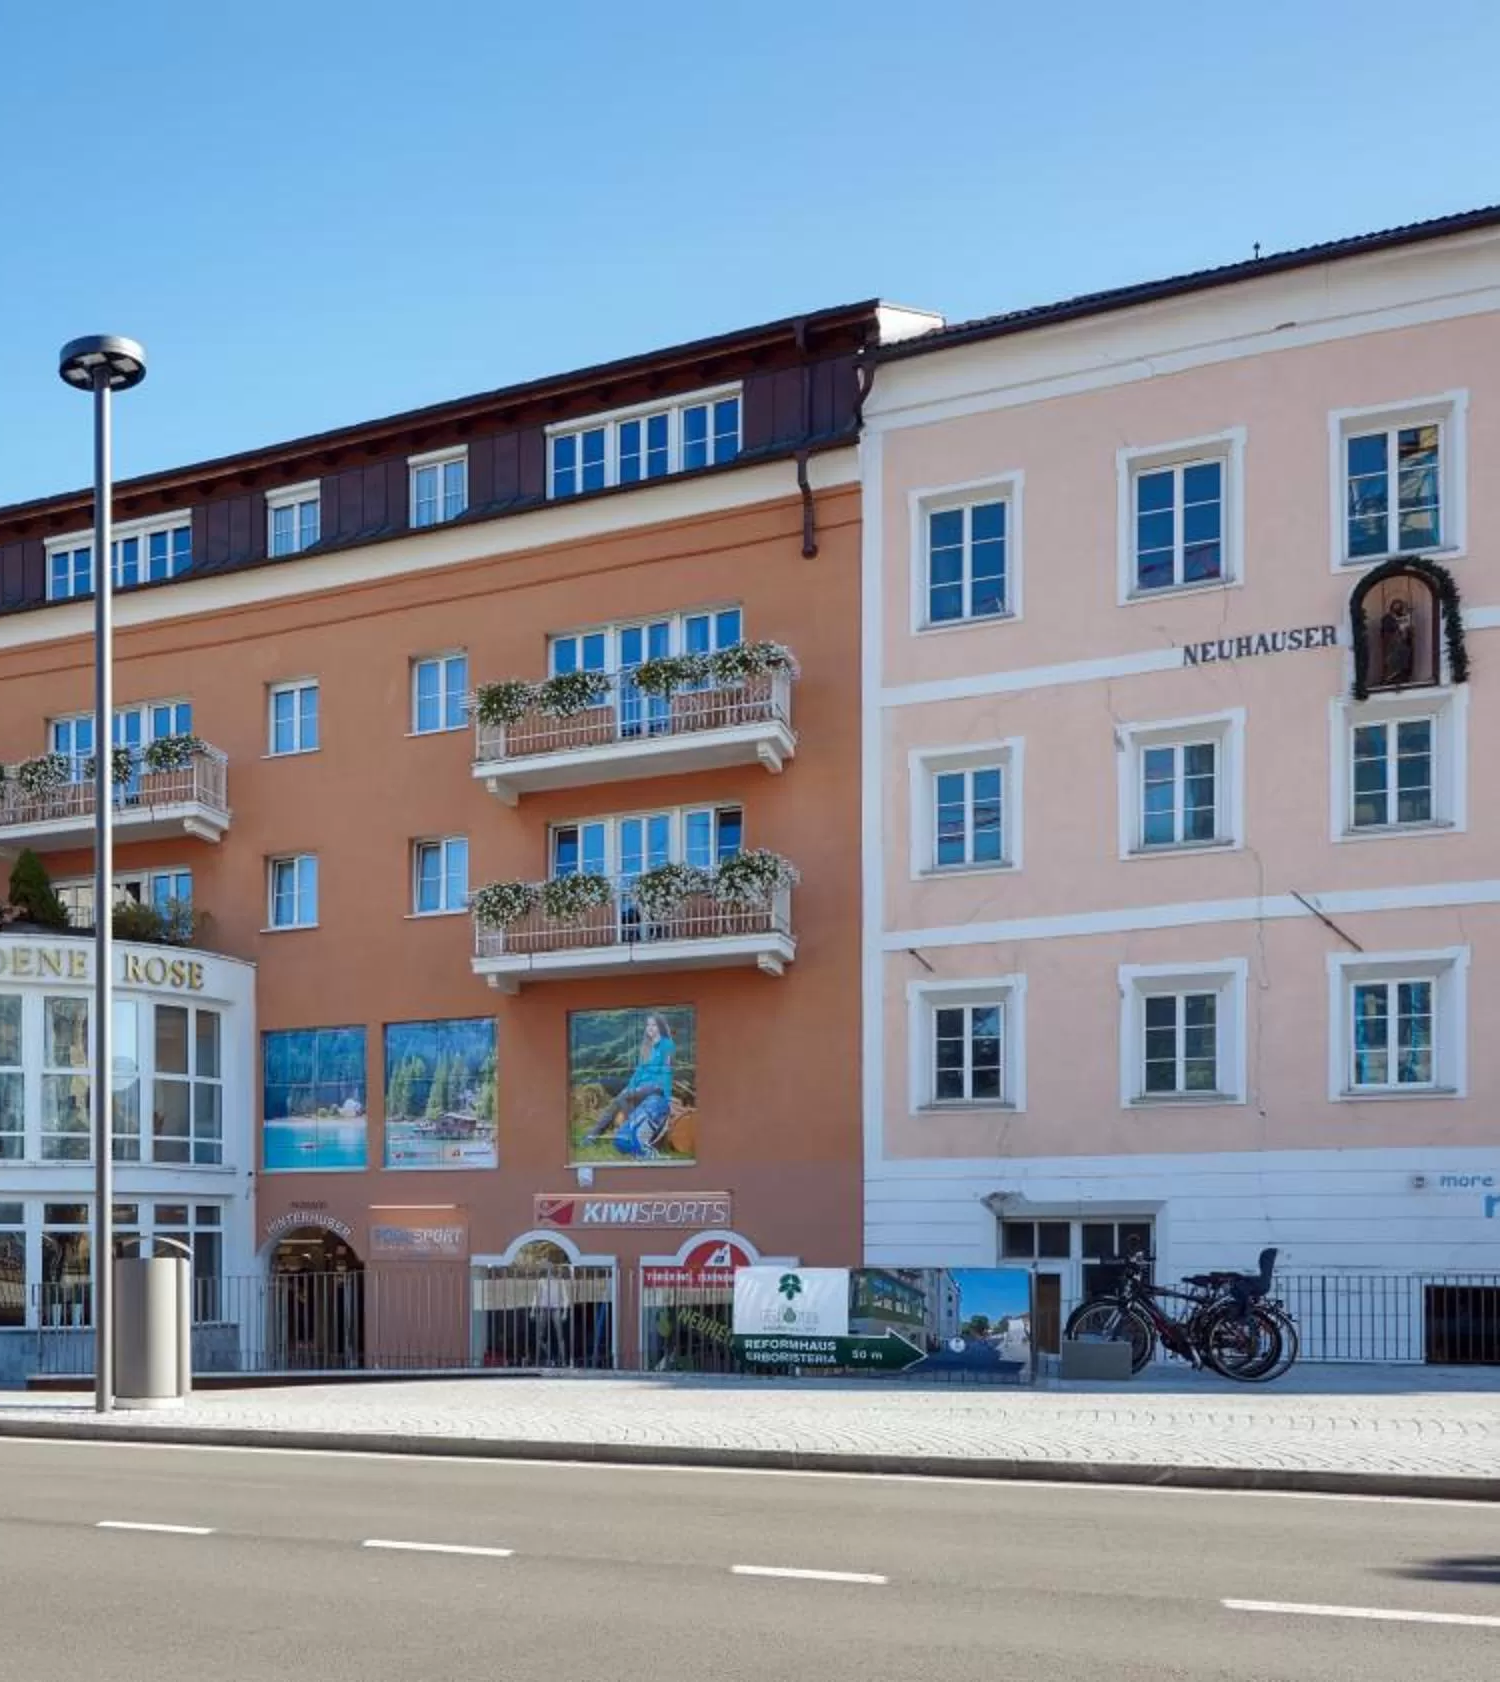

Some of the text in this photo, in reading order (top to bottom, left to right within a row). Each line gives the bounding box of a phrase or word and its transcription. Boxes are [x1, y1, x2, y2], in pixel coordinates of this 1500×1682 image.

[1183, 625, 1337, 667] NEUHAUSER
[123, 952, 205, 990] ROSE
[1440, 1175, 1494, 1188] more
[583, 1201, 729, 1224] KIWISPORTS
[744, 1339, 837, 1351] REFORMHAUS
[745, 1351, 837, 1364] ERBORISTERIA
[852, 1349, 883, 1360] 50 m
